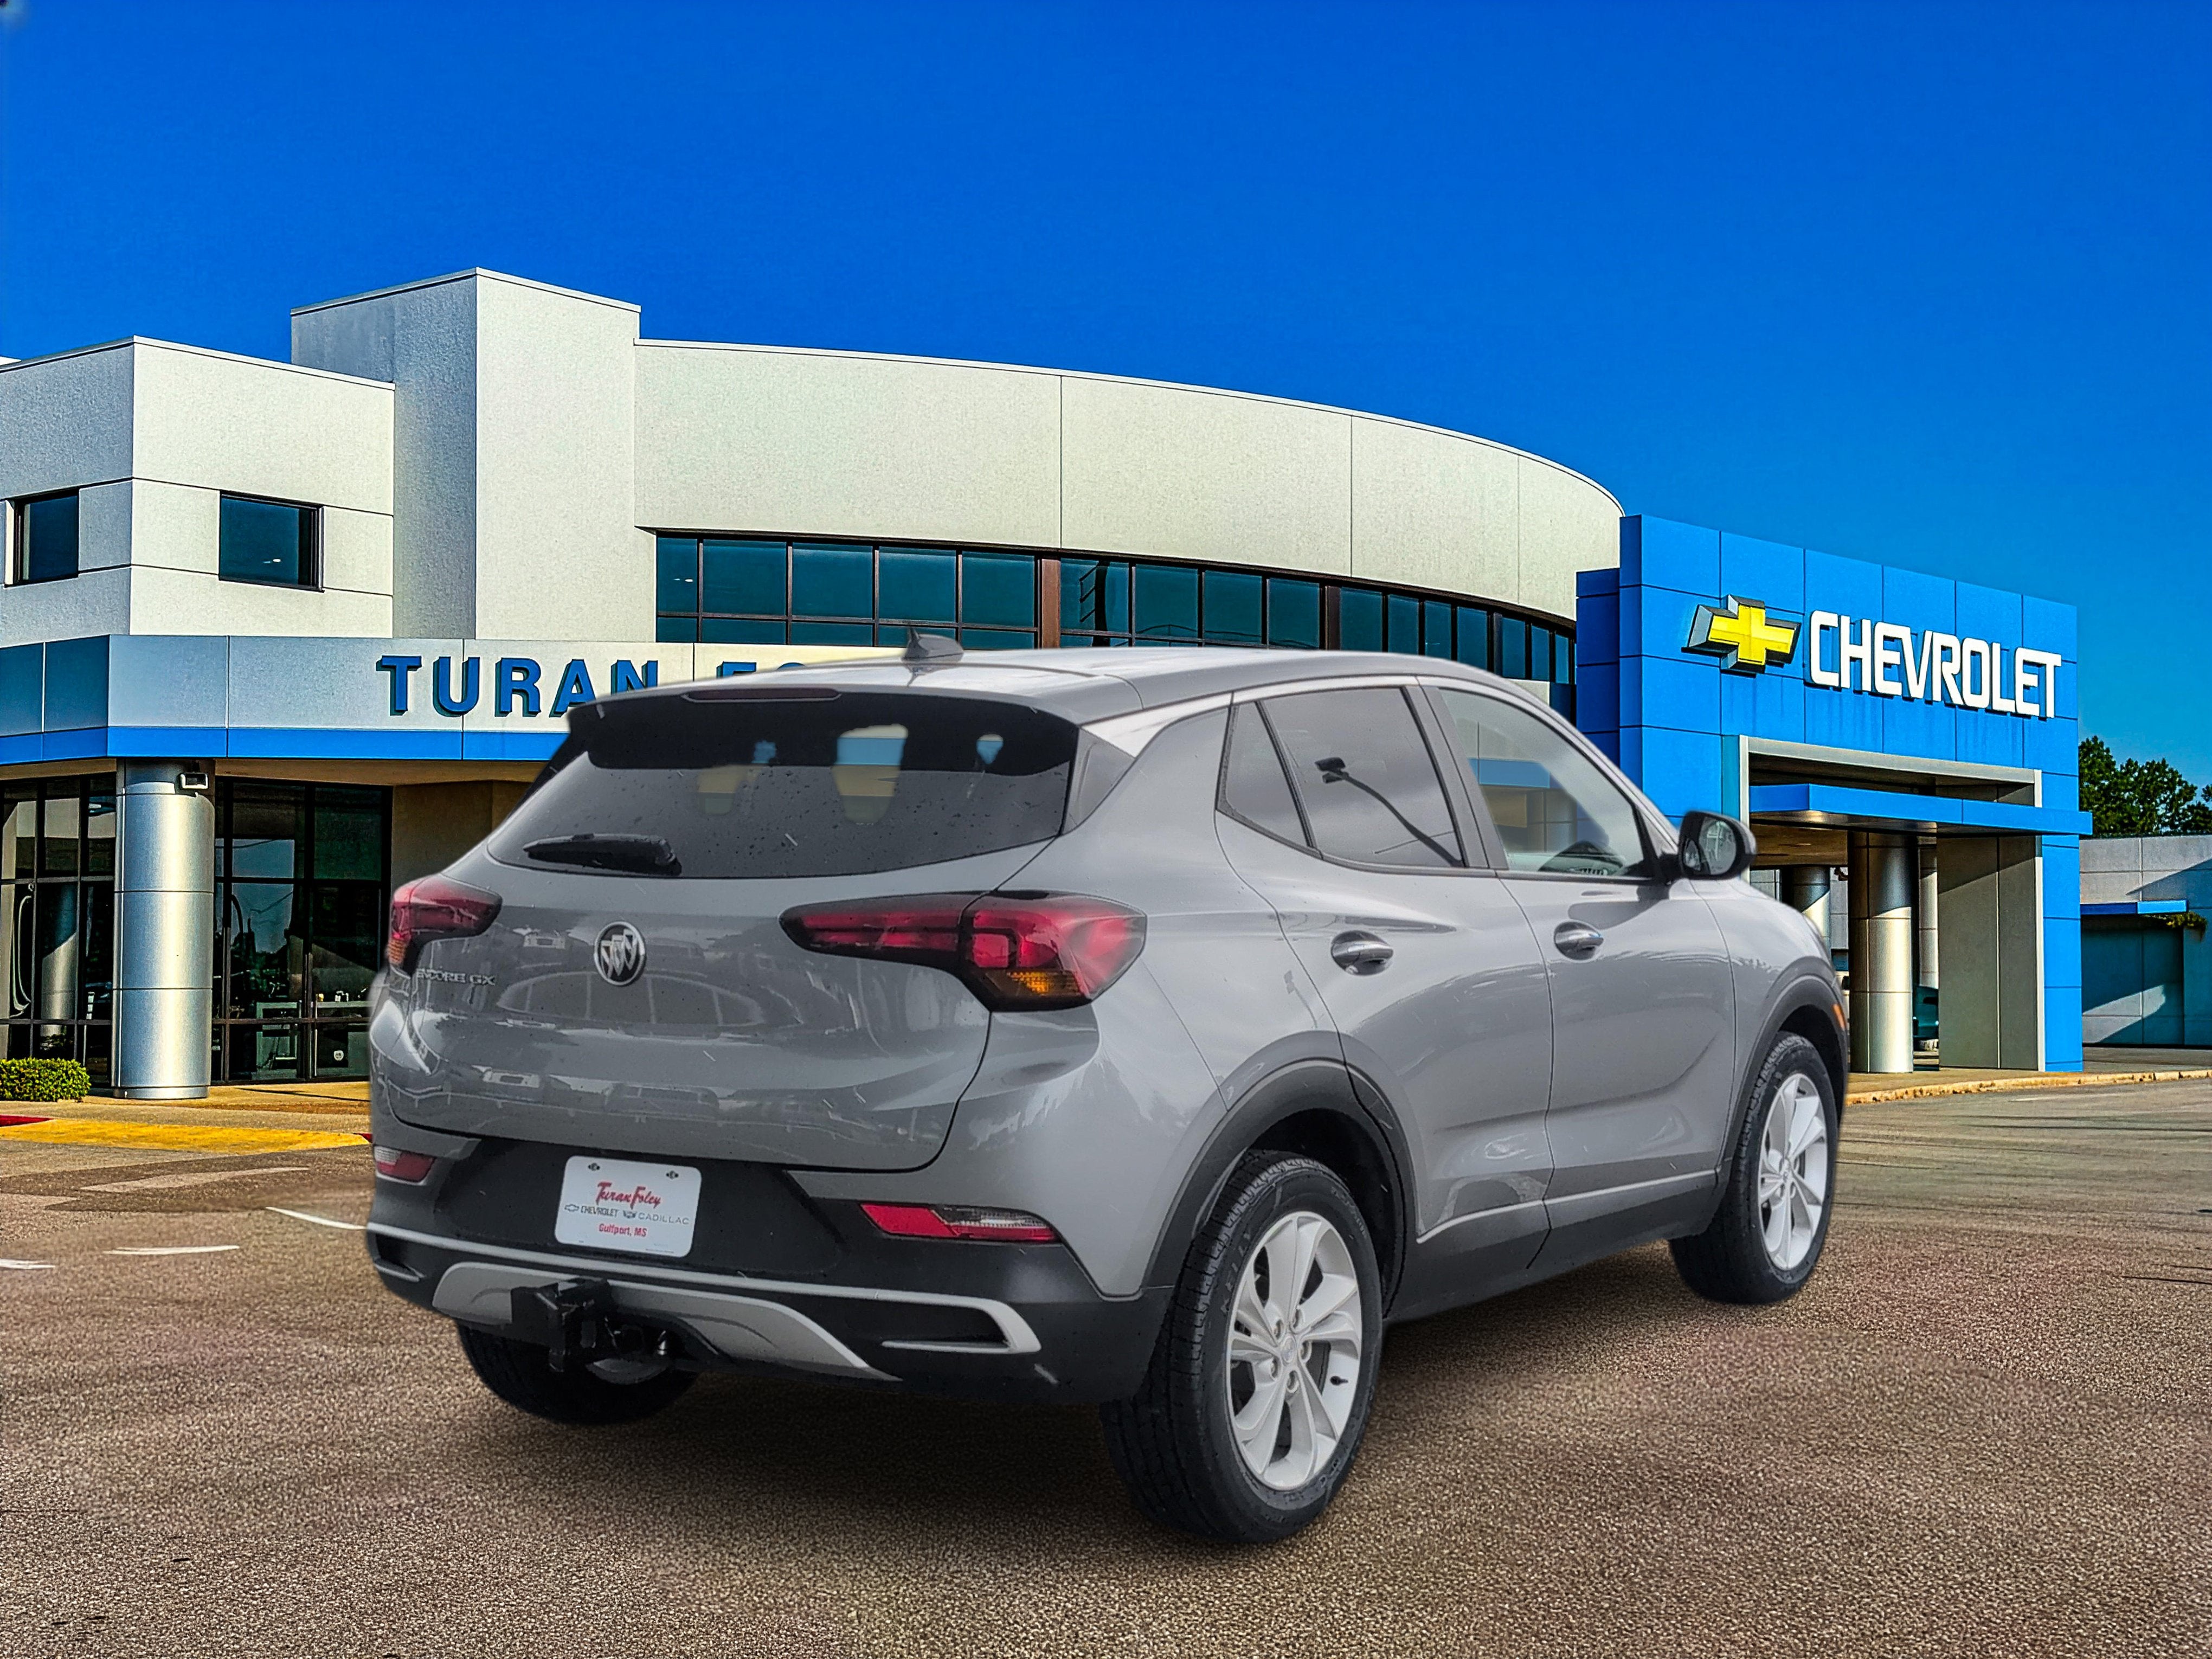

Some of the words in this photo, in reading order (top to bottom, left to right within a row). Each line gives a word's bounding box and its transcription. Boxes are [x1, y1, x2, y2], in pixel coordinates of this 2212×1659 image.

[1806, 610, 2062, 720] CHEVROLET
[470, 974, 496, 986] GX
[581, 1205, 618, 1218] CHEVROLET
[638, 1212, 689, 1225] CADILLAC
[599, 1223, 632, 1236] Gulfport,
[634, 1227, 647, 1237] MS
